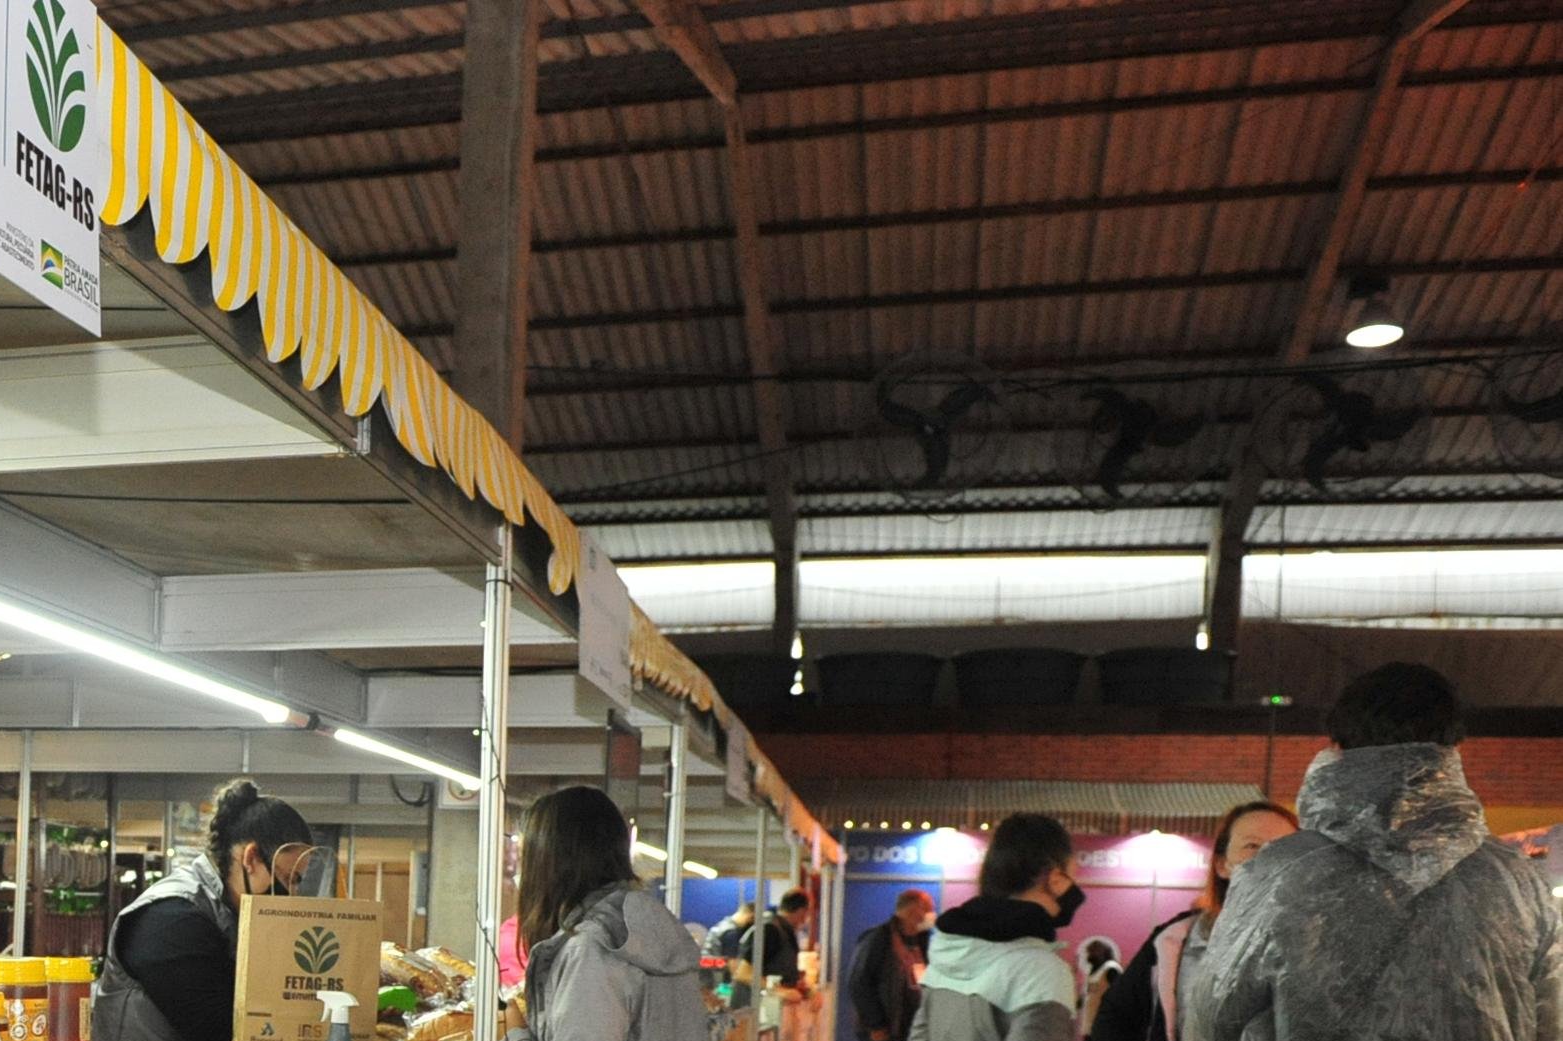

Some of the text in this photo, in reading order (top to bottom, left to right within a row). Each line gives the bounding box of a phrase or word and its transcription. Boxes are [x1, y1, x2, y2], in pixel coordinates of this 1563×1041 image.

[16, 130, 94, 232] FETAG-RS
[64, 268, 99, 307] BRASIL
[285, 976, 344, 991] FETAG-RS
